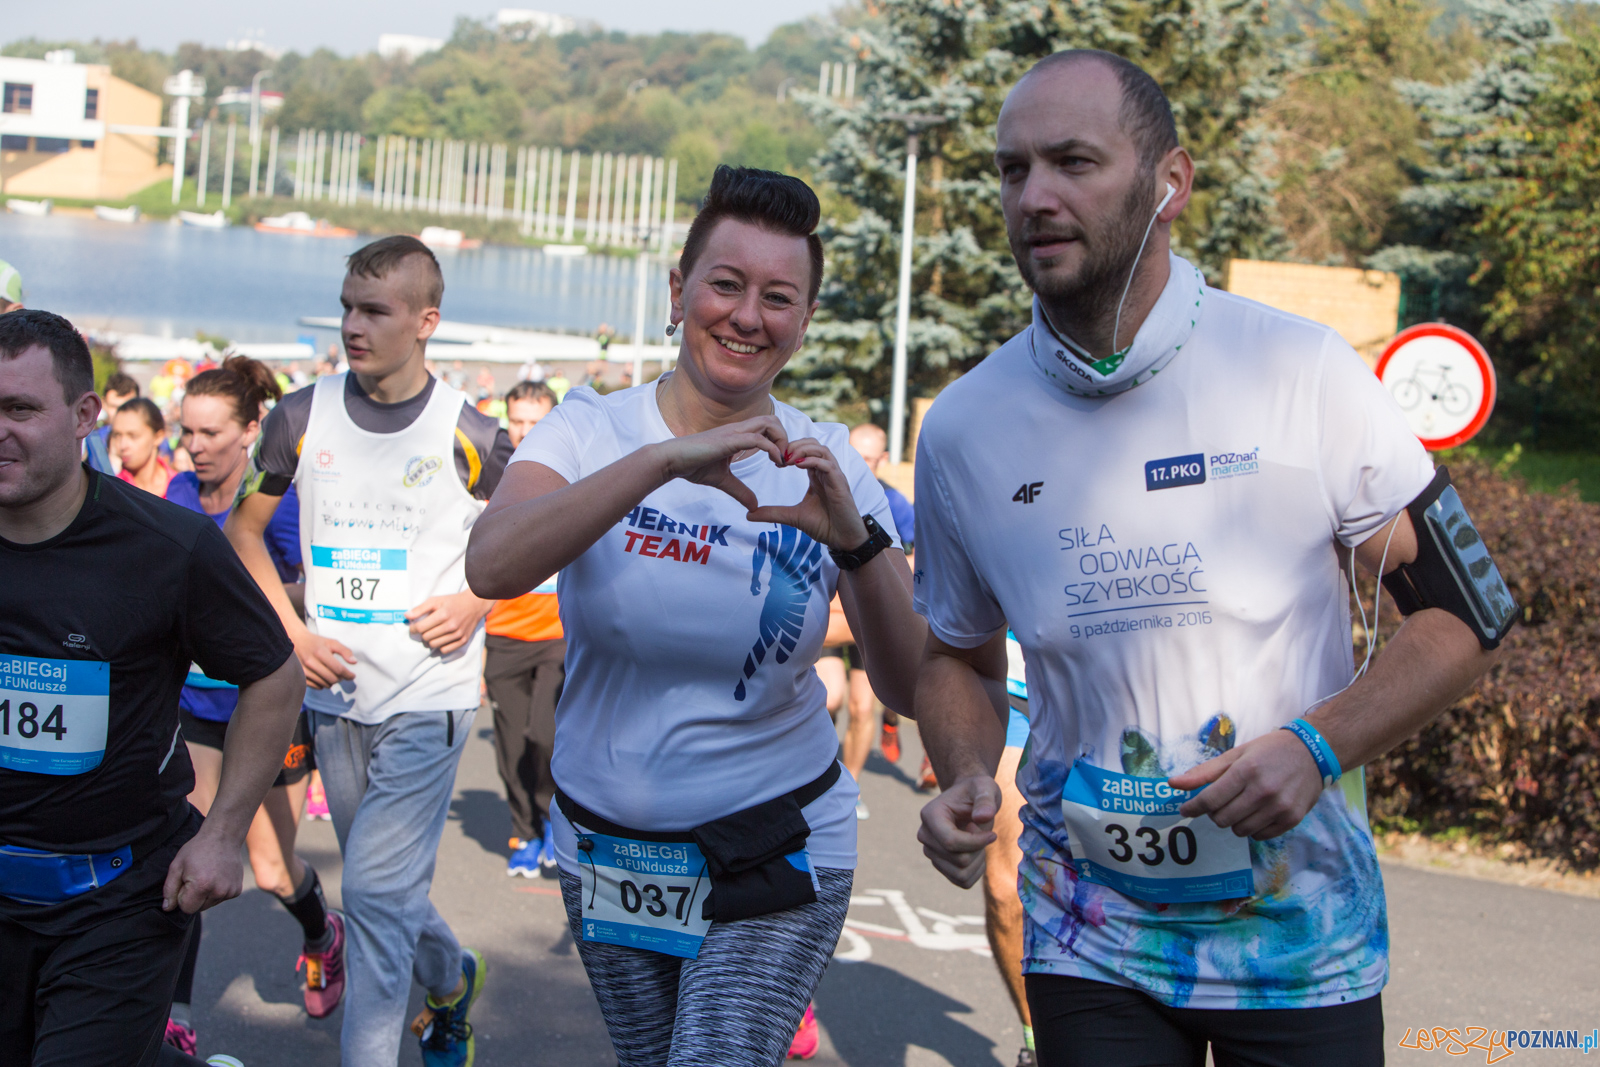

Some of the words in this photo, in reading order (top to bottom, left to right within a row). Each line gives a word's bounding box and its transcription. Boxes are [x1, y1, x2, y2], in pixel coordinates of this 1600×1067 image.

[1054, 349, 1093, 383] ŠKODA
[1211, 461, 1259, 476] maraton
[1012, 481, 1044, 504] 4F
[624, 530, 712, 565] TEAM
[1058, 524, 1115, 551] SIŁA
[331, 549, 381, 562] zaBIEGaj
[1079, 542, 1202, 576] ODWAGA
[336, 577, 381, 601] 187
[1064, 566, 1207, 606] SZYBKOŚĆ
[1069, 624, 1081, 638] 9
[1084, 614, 1173, 640] października
[1177, 611, 1213, 627] 2016
[5, 676, 67, 692] FUNdusze
[0, 699, 68, 741] 184
[1102, 799, 1110, 809] o
[1114, 798, 1184, 814] FUNdusz
[612, 843, 688, 864] zaBIEGaj
[1104, 824, 1198, 866] 330
[616, 859, 623, 867] o
[625, 858, 688, 874] FUNdusze
[619, 879, 691, 920] 037
